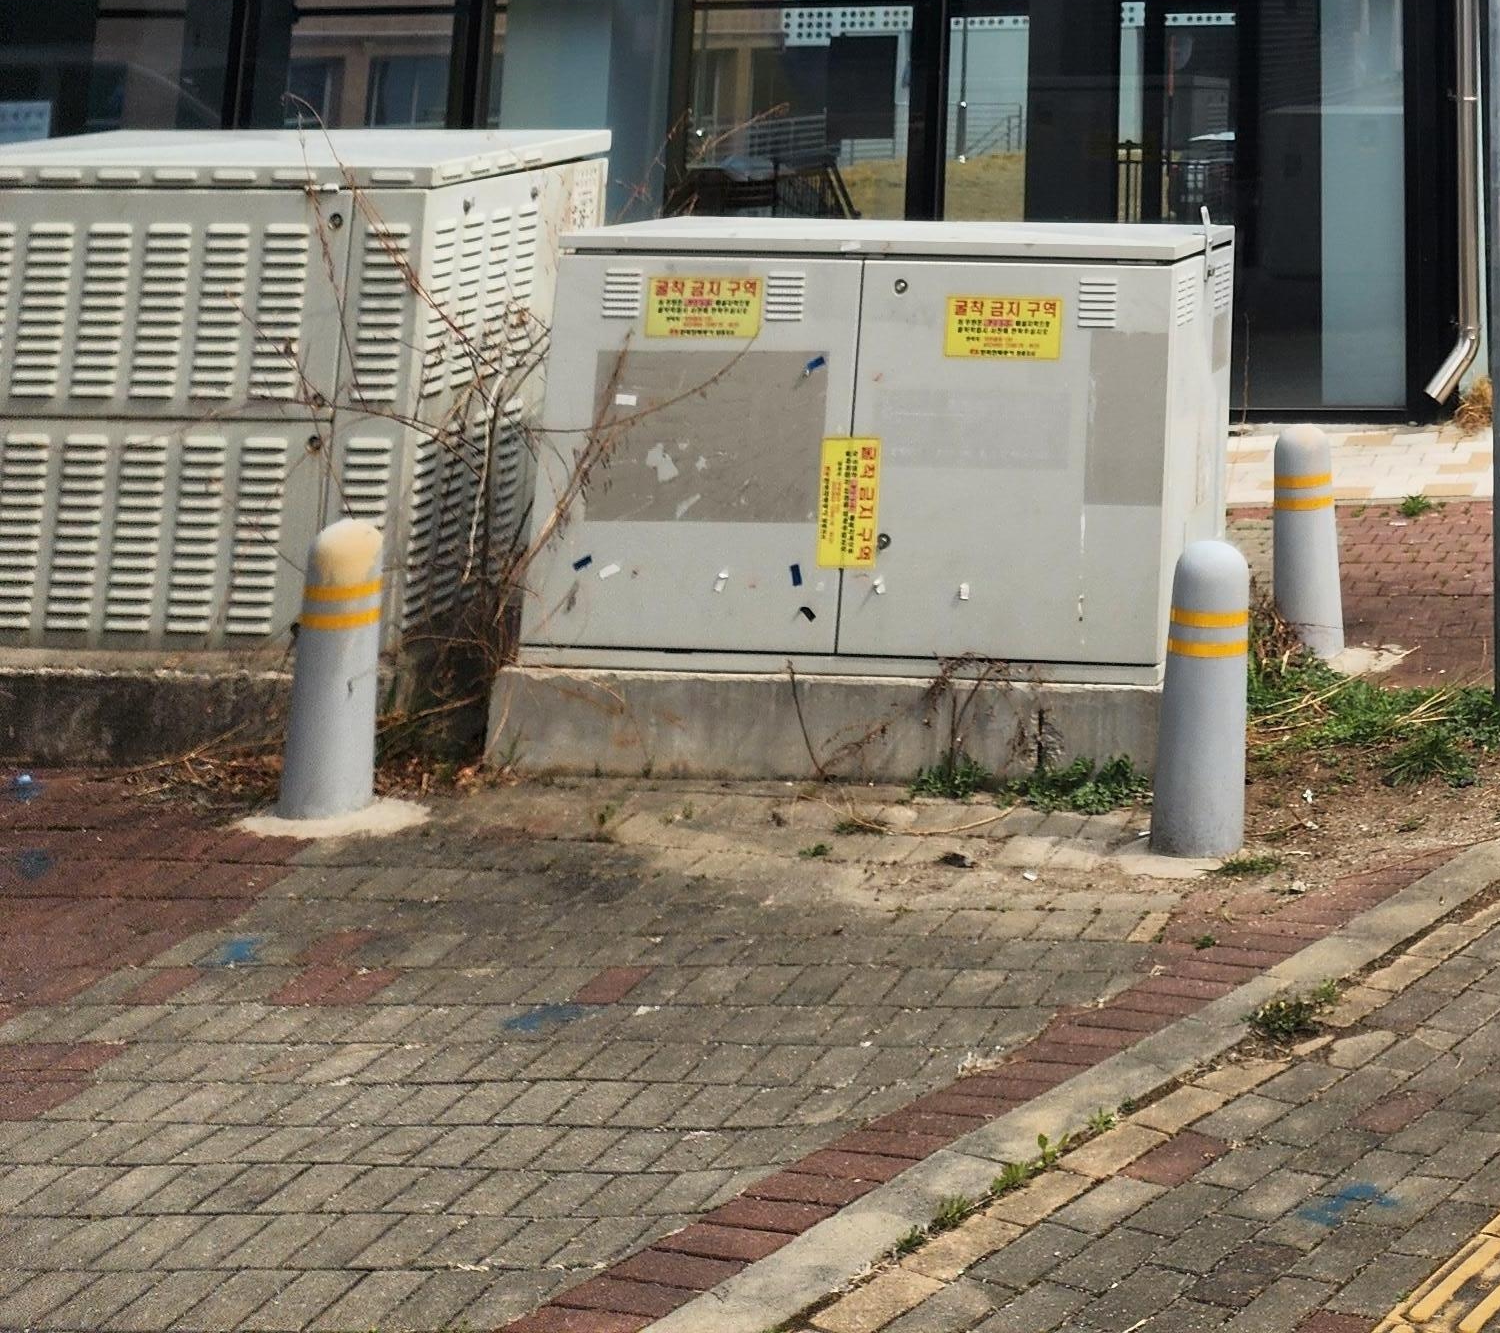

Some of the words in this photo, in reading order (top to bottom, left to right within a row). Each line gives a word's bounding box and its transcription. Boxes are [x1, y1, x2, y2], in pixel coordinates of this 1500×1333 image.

[691, 280, 721, 297] 금지
[727, 280, 757, 298] 구역
[955, 300, 985, 316] 굴착
[991, 301, 1020, 318] 금지
[1027, 301, 1056, 318] 구역
[858, 486, 875, 519] 금지
[856, 528, 873, 561] 구역
